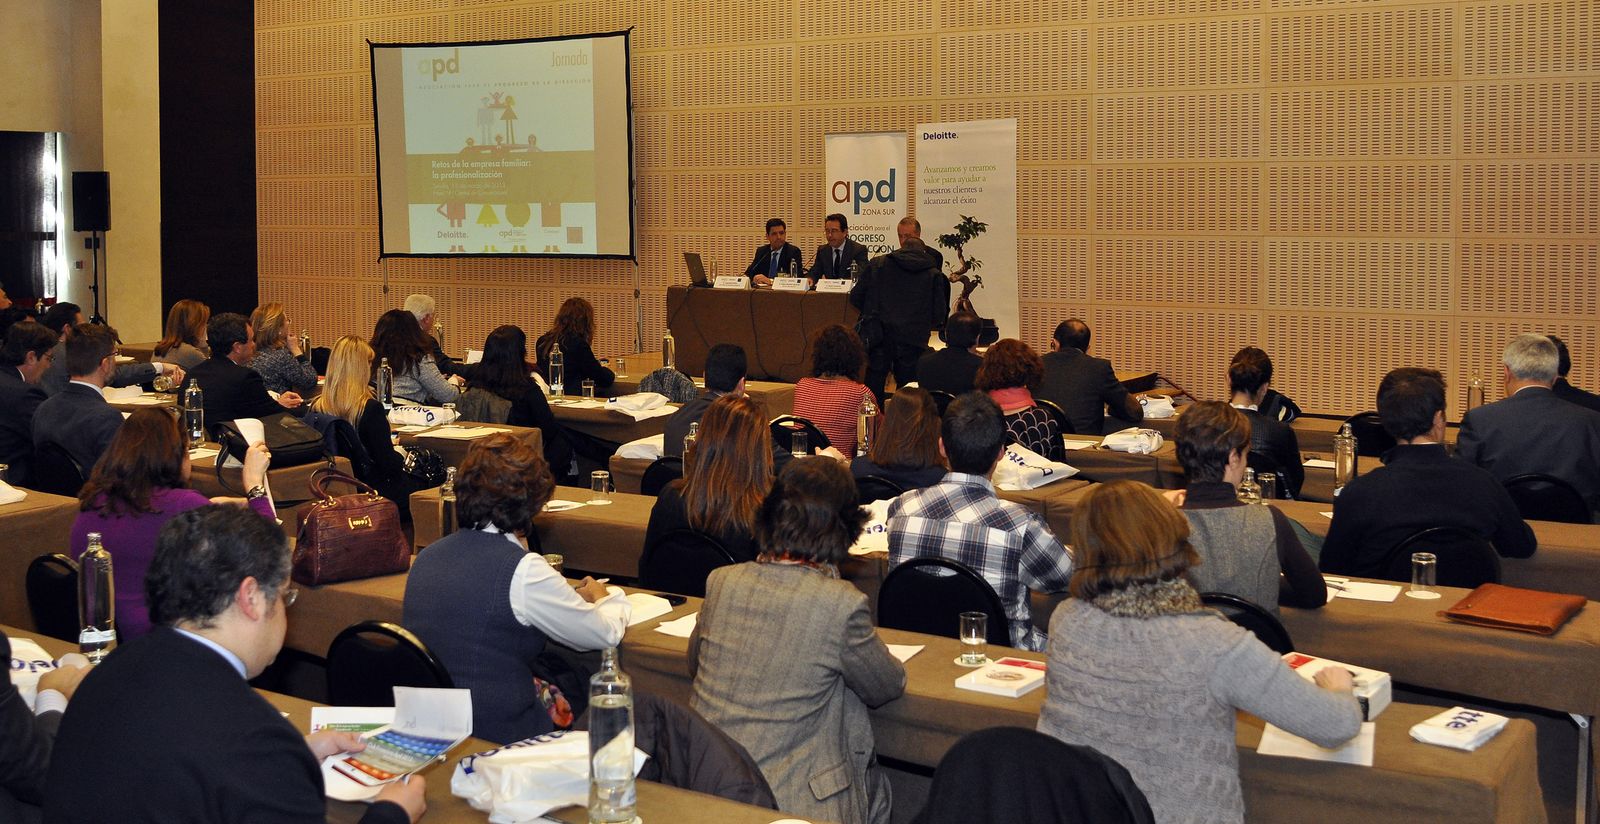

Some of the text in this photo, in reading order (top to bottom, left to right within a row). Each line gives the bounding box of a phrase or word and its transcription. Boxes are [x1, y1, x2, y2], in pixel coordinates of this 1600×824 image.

[551, 49, 588, 67] Jornada
[418, 48, 460, 81] apd
[923, 131, 959, 140] Deloitte.
[431, 158, 532, 169] Retos de la empresa familiar:
[923, 164, 997, 174] Avanzamos y creamos
[432, 170, 503, 181] la profesionalización
[923, 176, 941, 184] valor
[941, 177, 957, 185] para
[957, 175, 981, 184] ayudar
[832, 168, 896, 214] apd
[952, 185, 978, 194] clientes
[923, 196, 977, 205] alcanzar el éxito
[882, 208, 896, 216] SUR
[847, 223, 874, 231] ciación
[437, 230, 469, 239] Deloitte.
